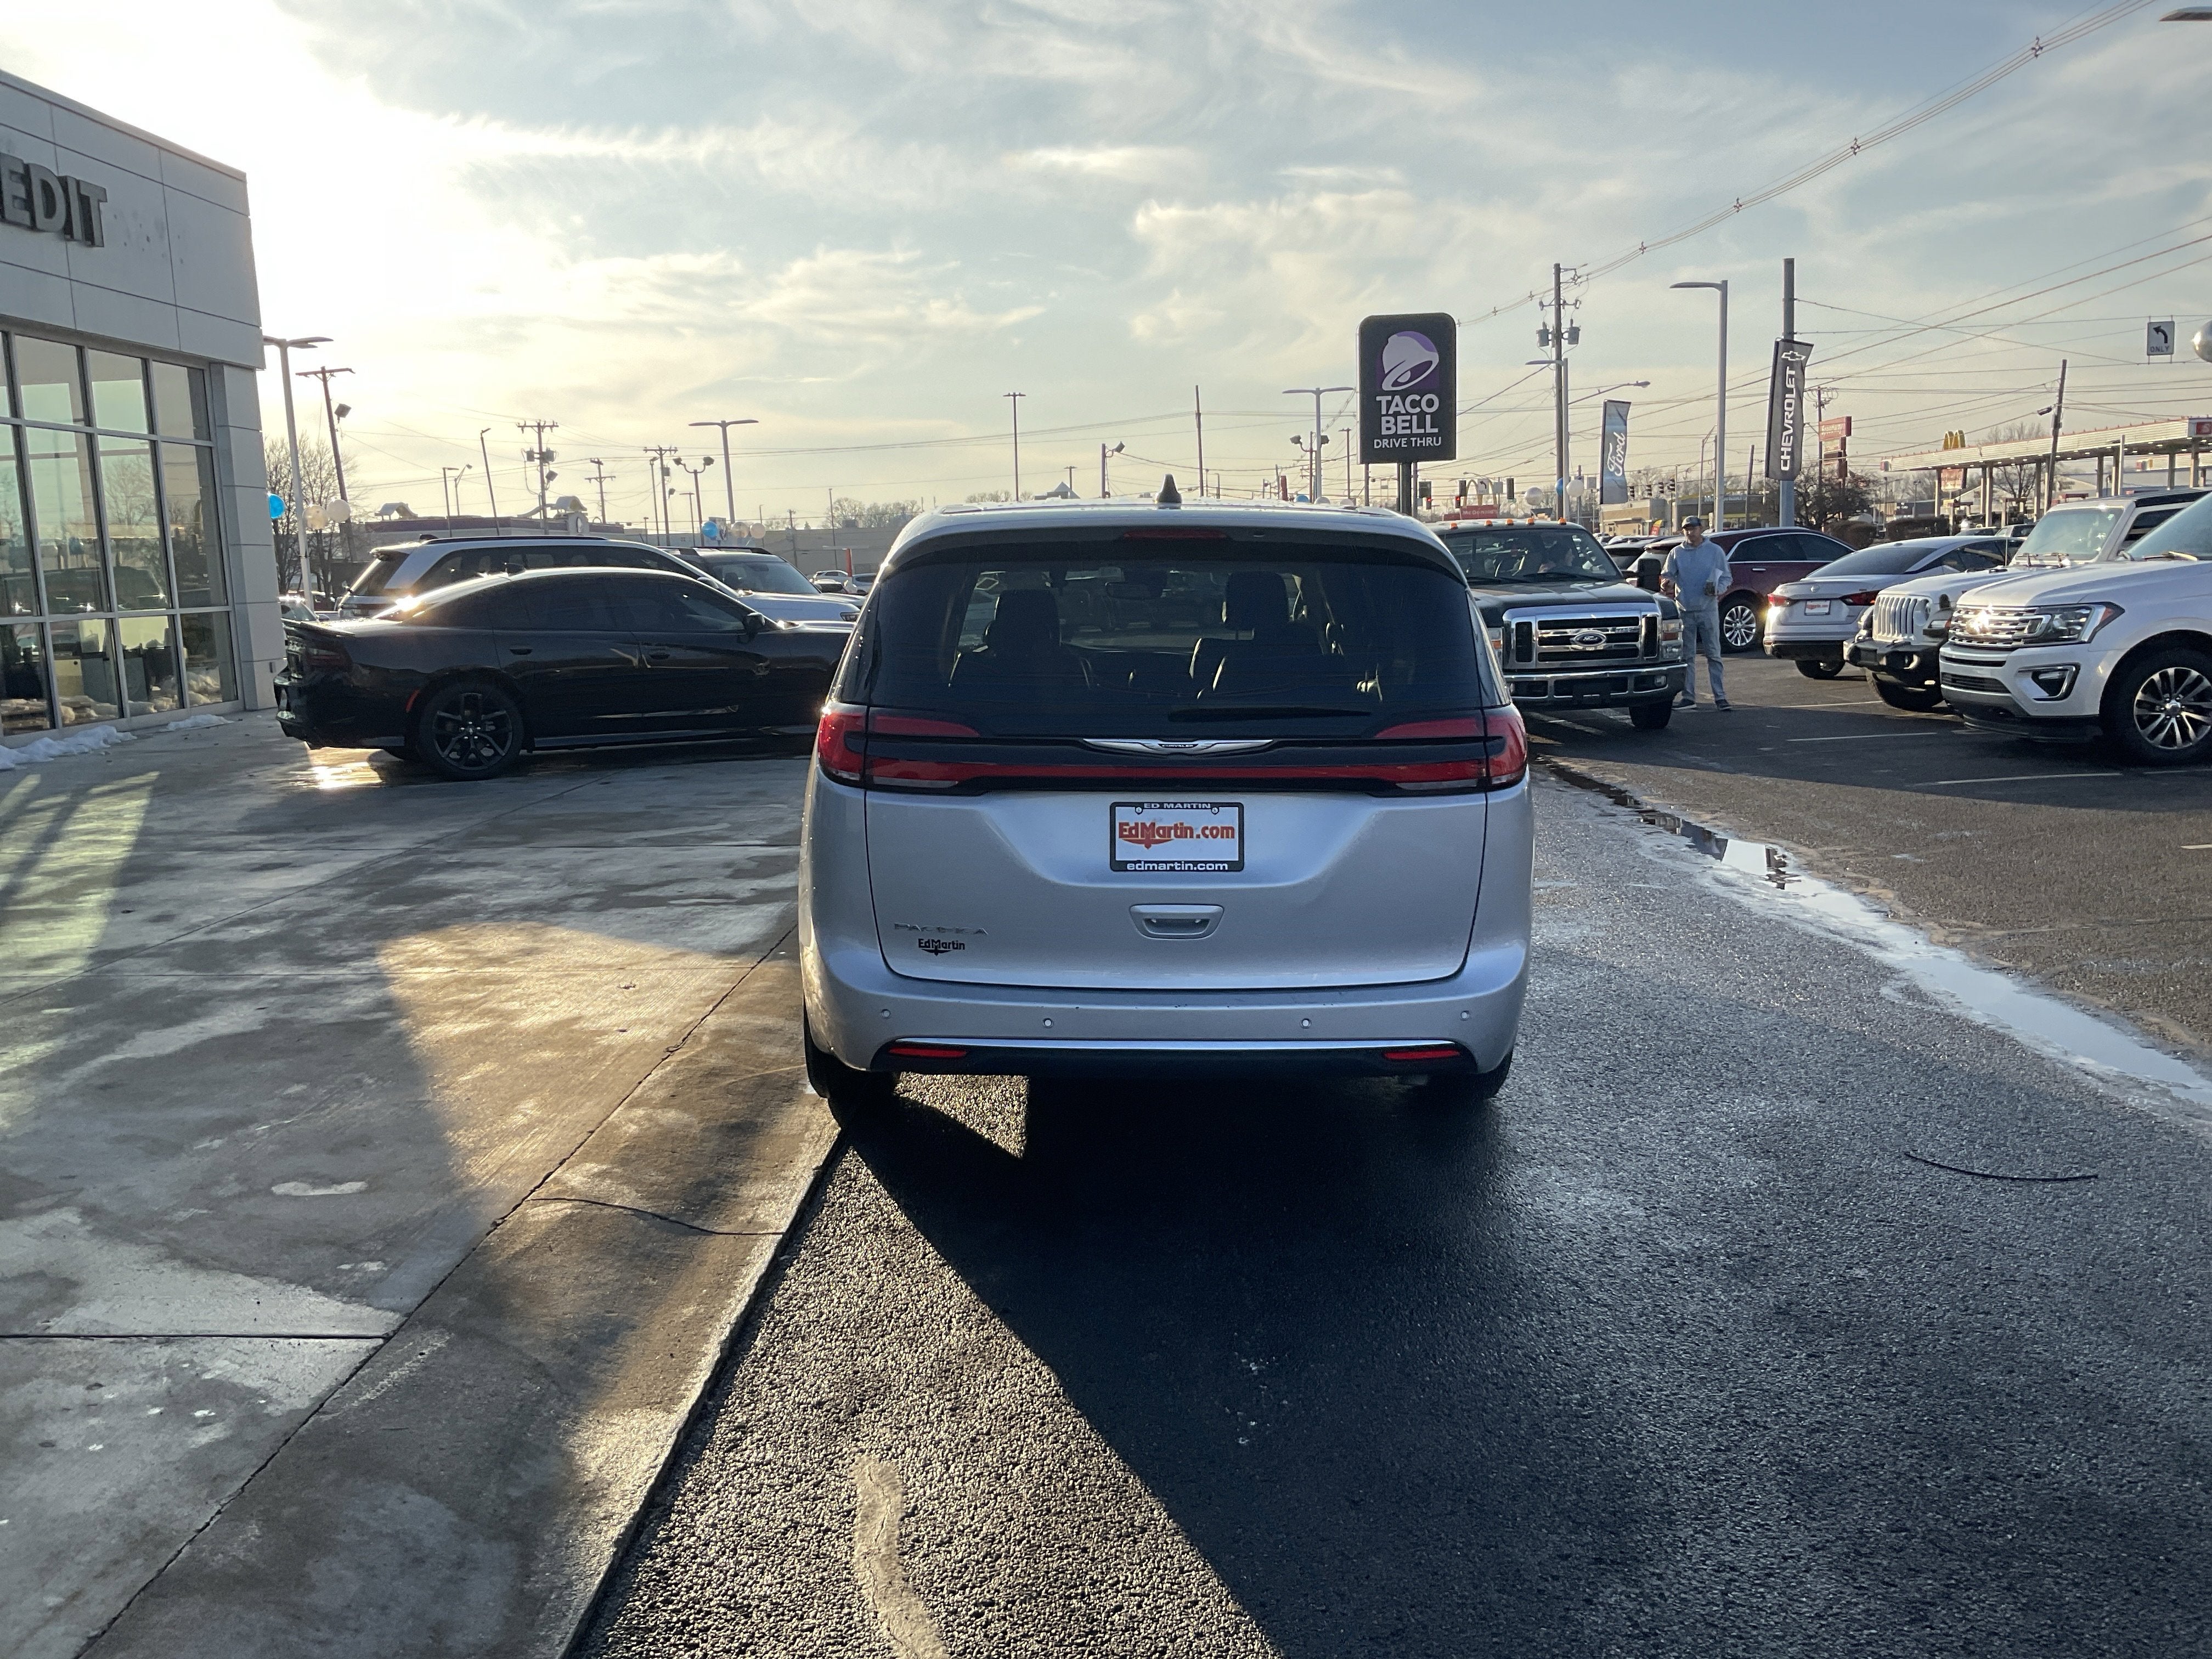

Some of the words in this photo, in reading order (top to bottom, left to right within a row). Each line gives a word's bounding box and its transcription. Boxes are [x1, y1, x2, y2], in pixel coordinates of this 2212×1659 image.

[0, 153, 108, 247] EDIT
[1376, 394, 1439, 414] TACO
[1381, 415, 1438, 435] BELL
[1781, 366, 1796, 471] CHEVROLET
[1374, 438, 1408, 448] DRIVE
[1410, 437, 1441, 447] THRU
[1607, 432, 1626, 476] Ford
[1118, 822, 1235, 839] EdMartin.com
[1127, 861, 1228, 870] edmartin.com
[918, 938, 965, 950] EdMartin
